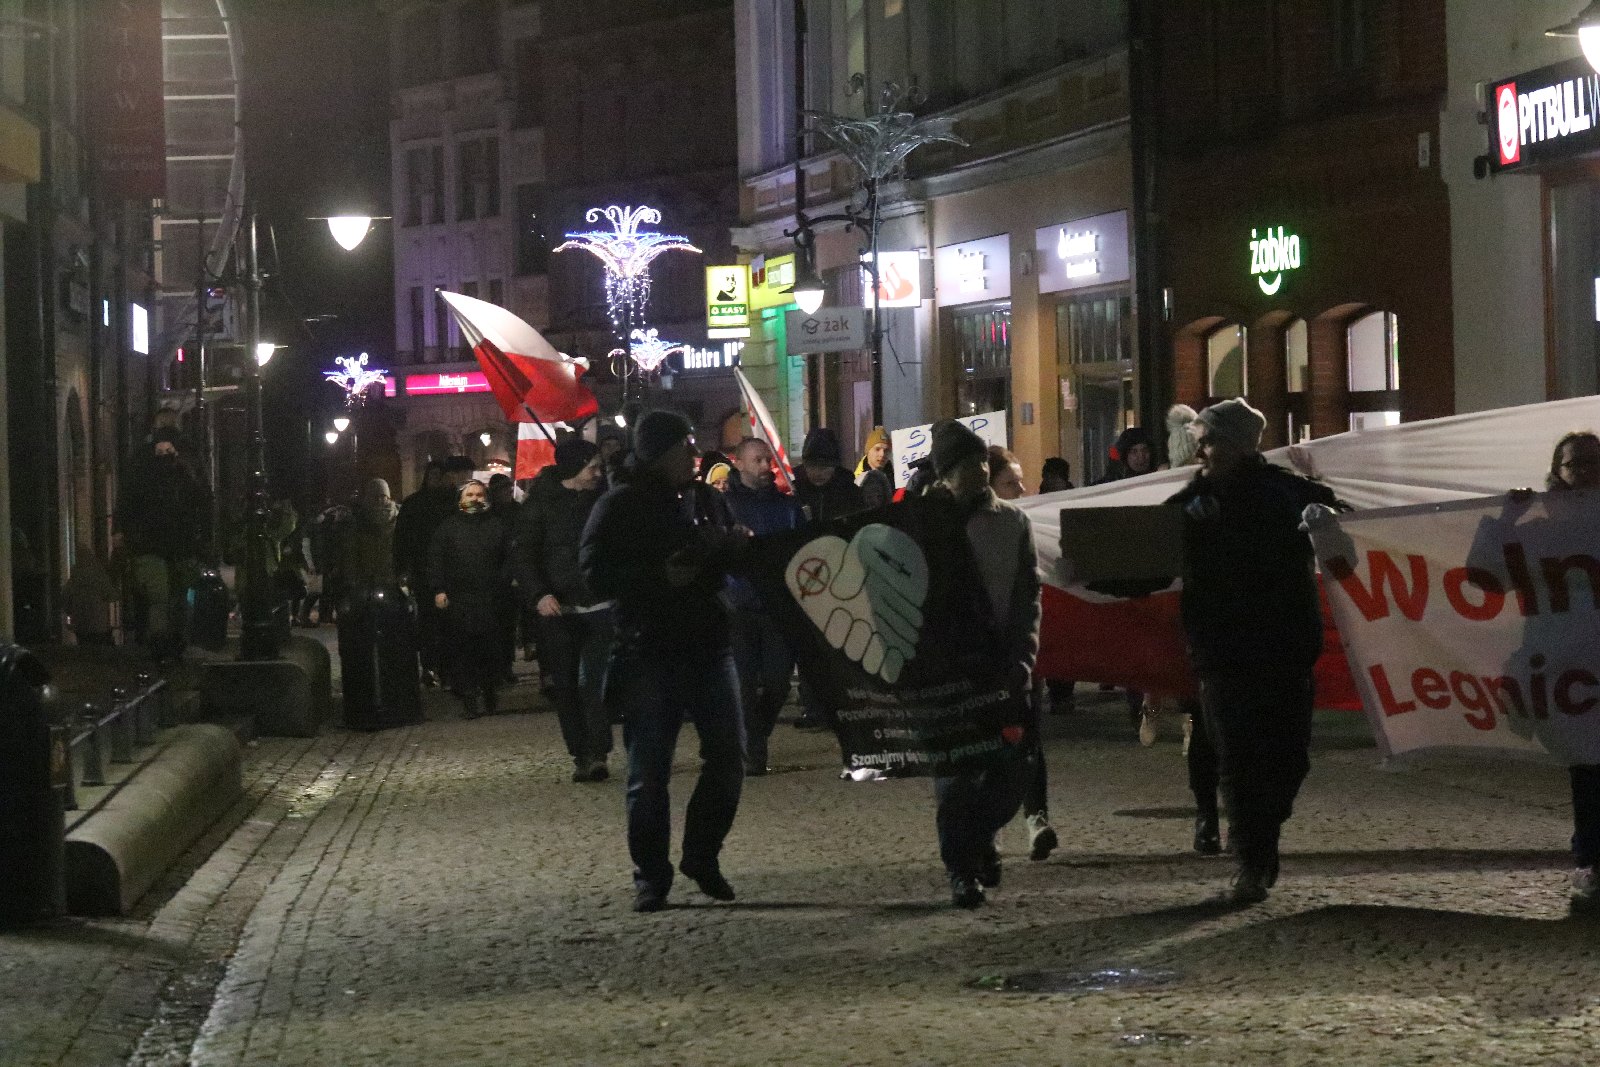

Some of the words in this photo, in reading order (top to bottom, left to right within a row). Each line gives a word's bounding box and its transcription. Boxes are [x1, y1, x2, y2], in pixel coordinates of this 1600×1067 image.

[1518, 77, 1590, 145] PITBULL
[1249, 225, 1301, 274] żabka
[824, 316, 849, 332] żak
[851, 749, 906, 769] Szanujmy
